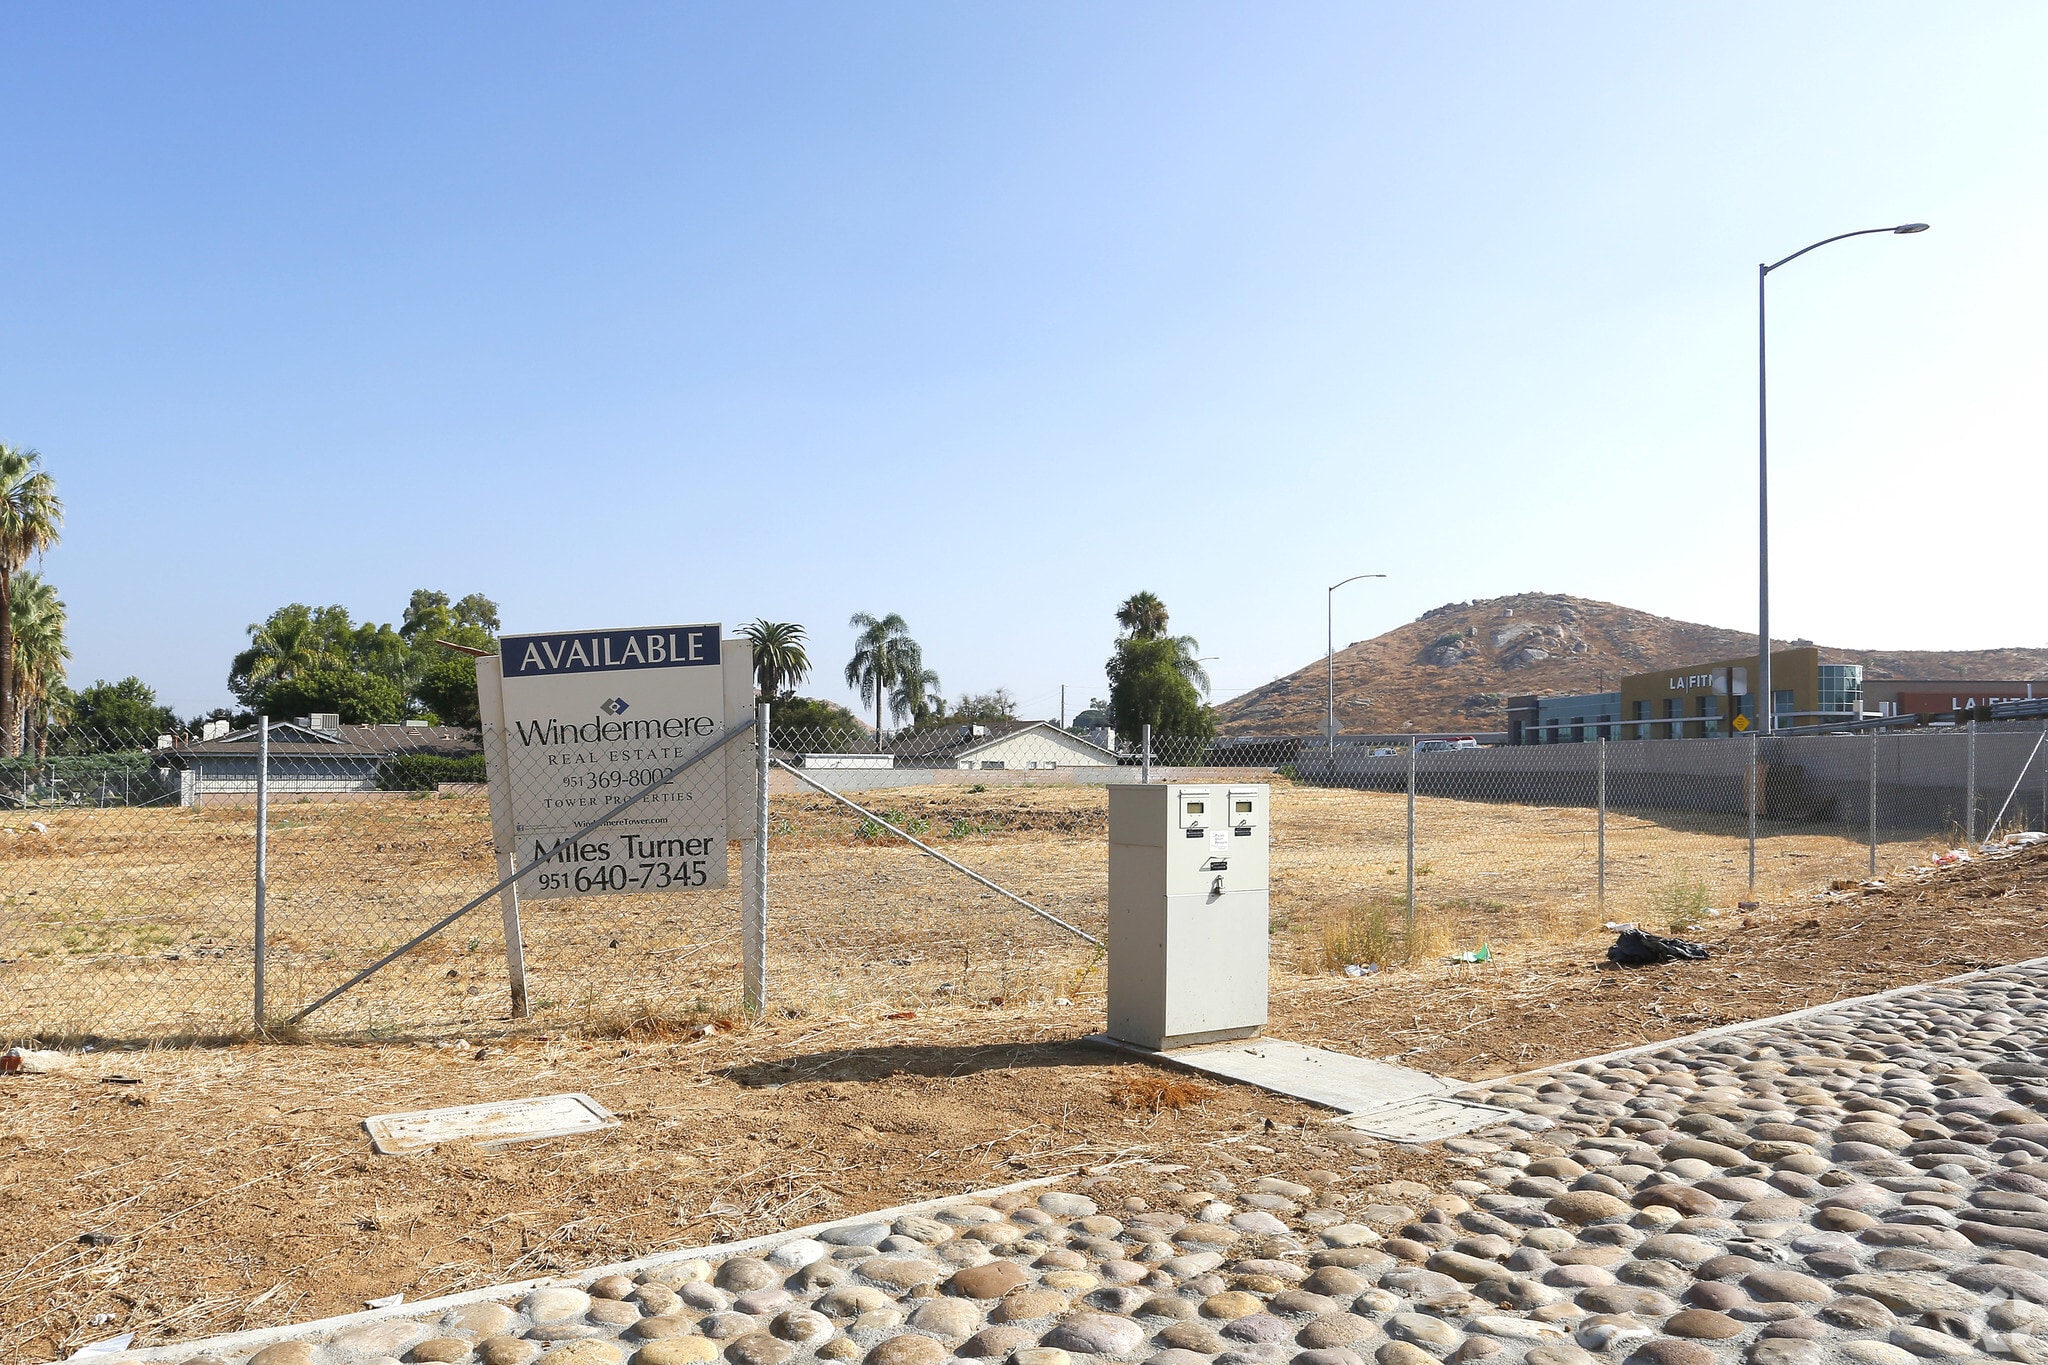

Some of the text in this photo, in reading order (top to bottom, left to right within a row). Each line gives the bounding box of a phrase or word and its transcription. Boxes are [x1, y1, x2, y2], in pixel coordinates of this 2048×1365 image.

[520, 632, 704, 671] AVAILABLE
[515, 715, 715, 747] Windermere
[548, 747, 684, 765] REAL ESTATE
[563, 777, 583, 788] 951
[544, 792, 693, 808] TOWER PROERTIES
[534, 834, 714, 864] Miles Turner
[538, 860, 707, 893] 951 640-7345
